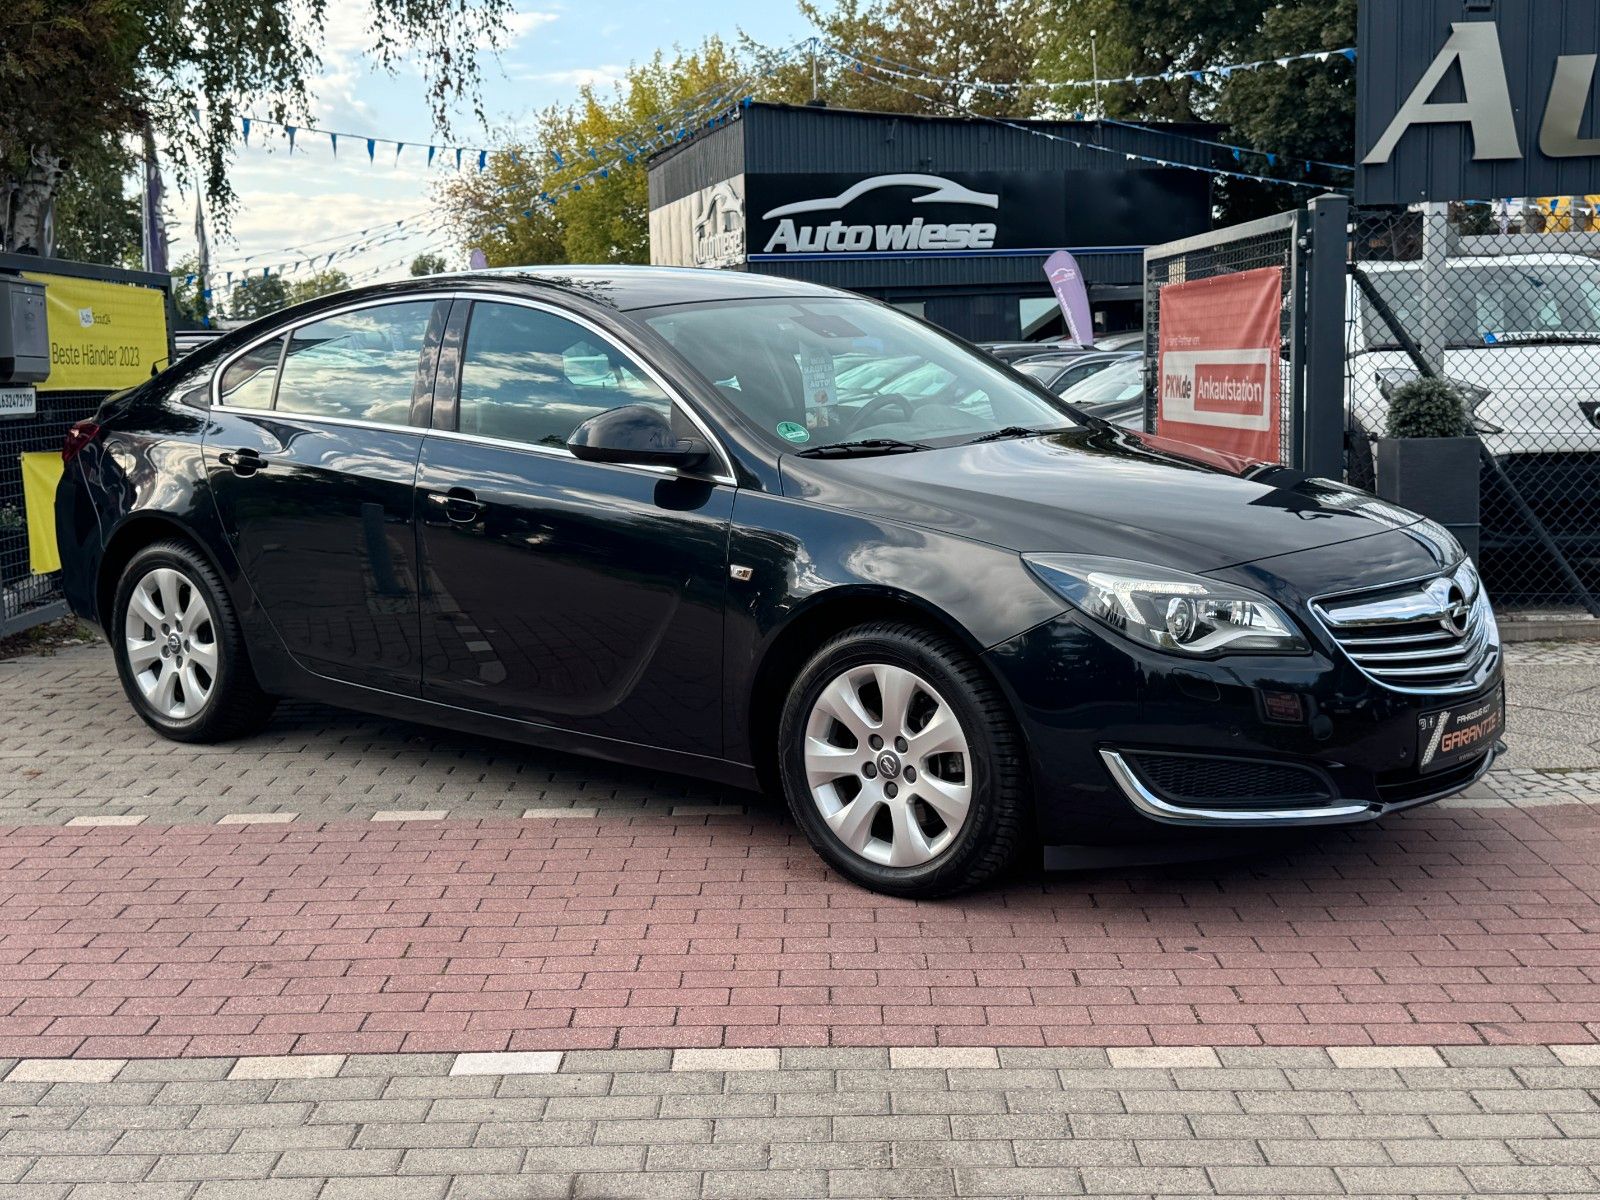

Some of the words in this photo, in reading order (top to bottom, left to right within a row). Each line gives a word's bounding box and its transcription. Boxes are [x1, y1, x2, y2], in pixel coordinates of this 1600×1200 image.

[763, 217, 998, 252] Autowiese
[52, 342, 80, 365] Beste
[82, 343, 117, 366] Händler
[119, 346, 140, 367] 2023
[1165, 374, 1192, 399] PKW.de
[1197, 375, 1262, 402] Ankaufstation
[1441, 711, 1497, 752] GARANTIE
